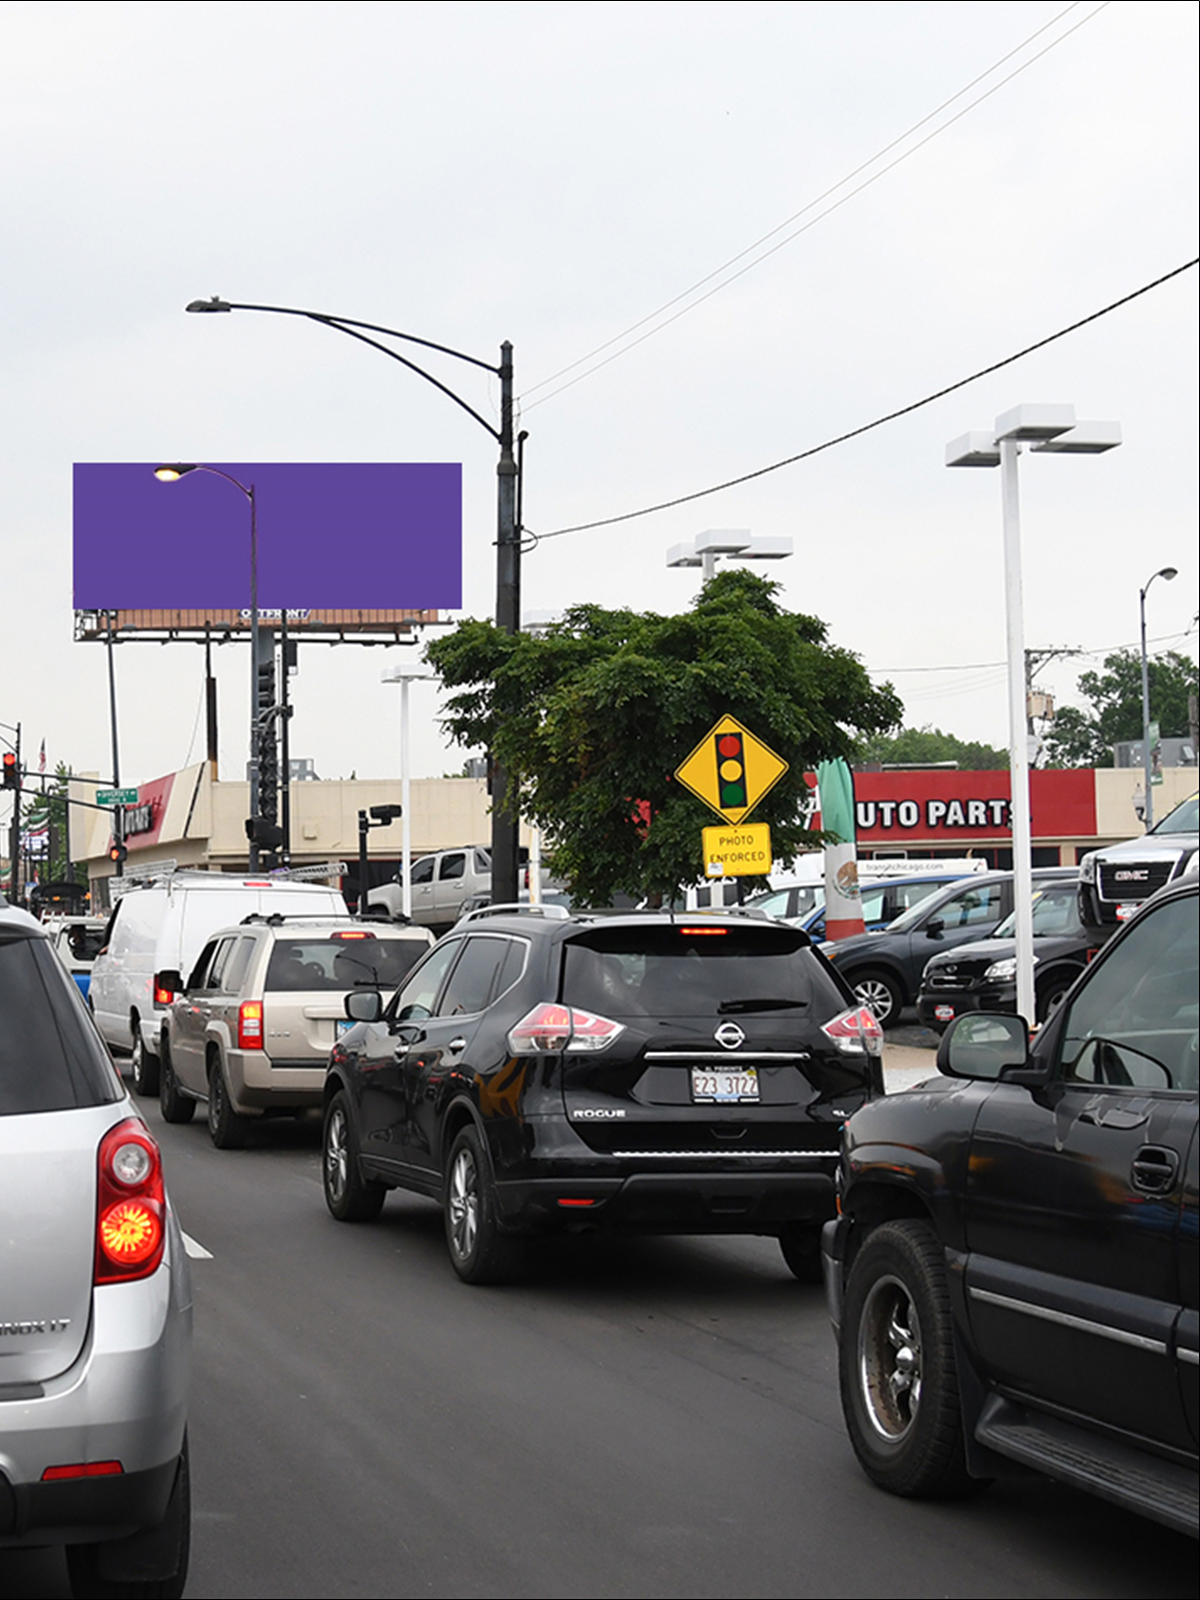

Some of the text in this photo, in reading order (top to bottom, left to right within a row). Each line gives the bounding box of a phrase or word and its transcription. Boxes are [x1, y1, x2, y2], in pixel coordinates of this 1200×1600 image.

[857, 802, 918, 827] UTO
[719, 835, 754, 846] PHOTO
[710, 851, 765, 863] ENFORCED
[1115, 870, 1149, 881] GMC
[694, 1077, 757, 1095] E23 3722
[573, 1109, 626, 1118] ROGUE
